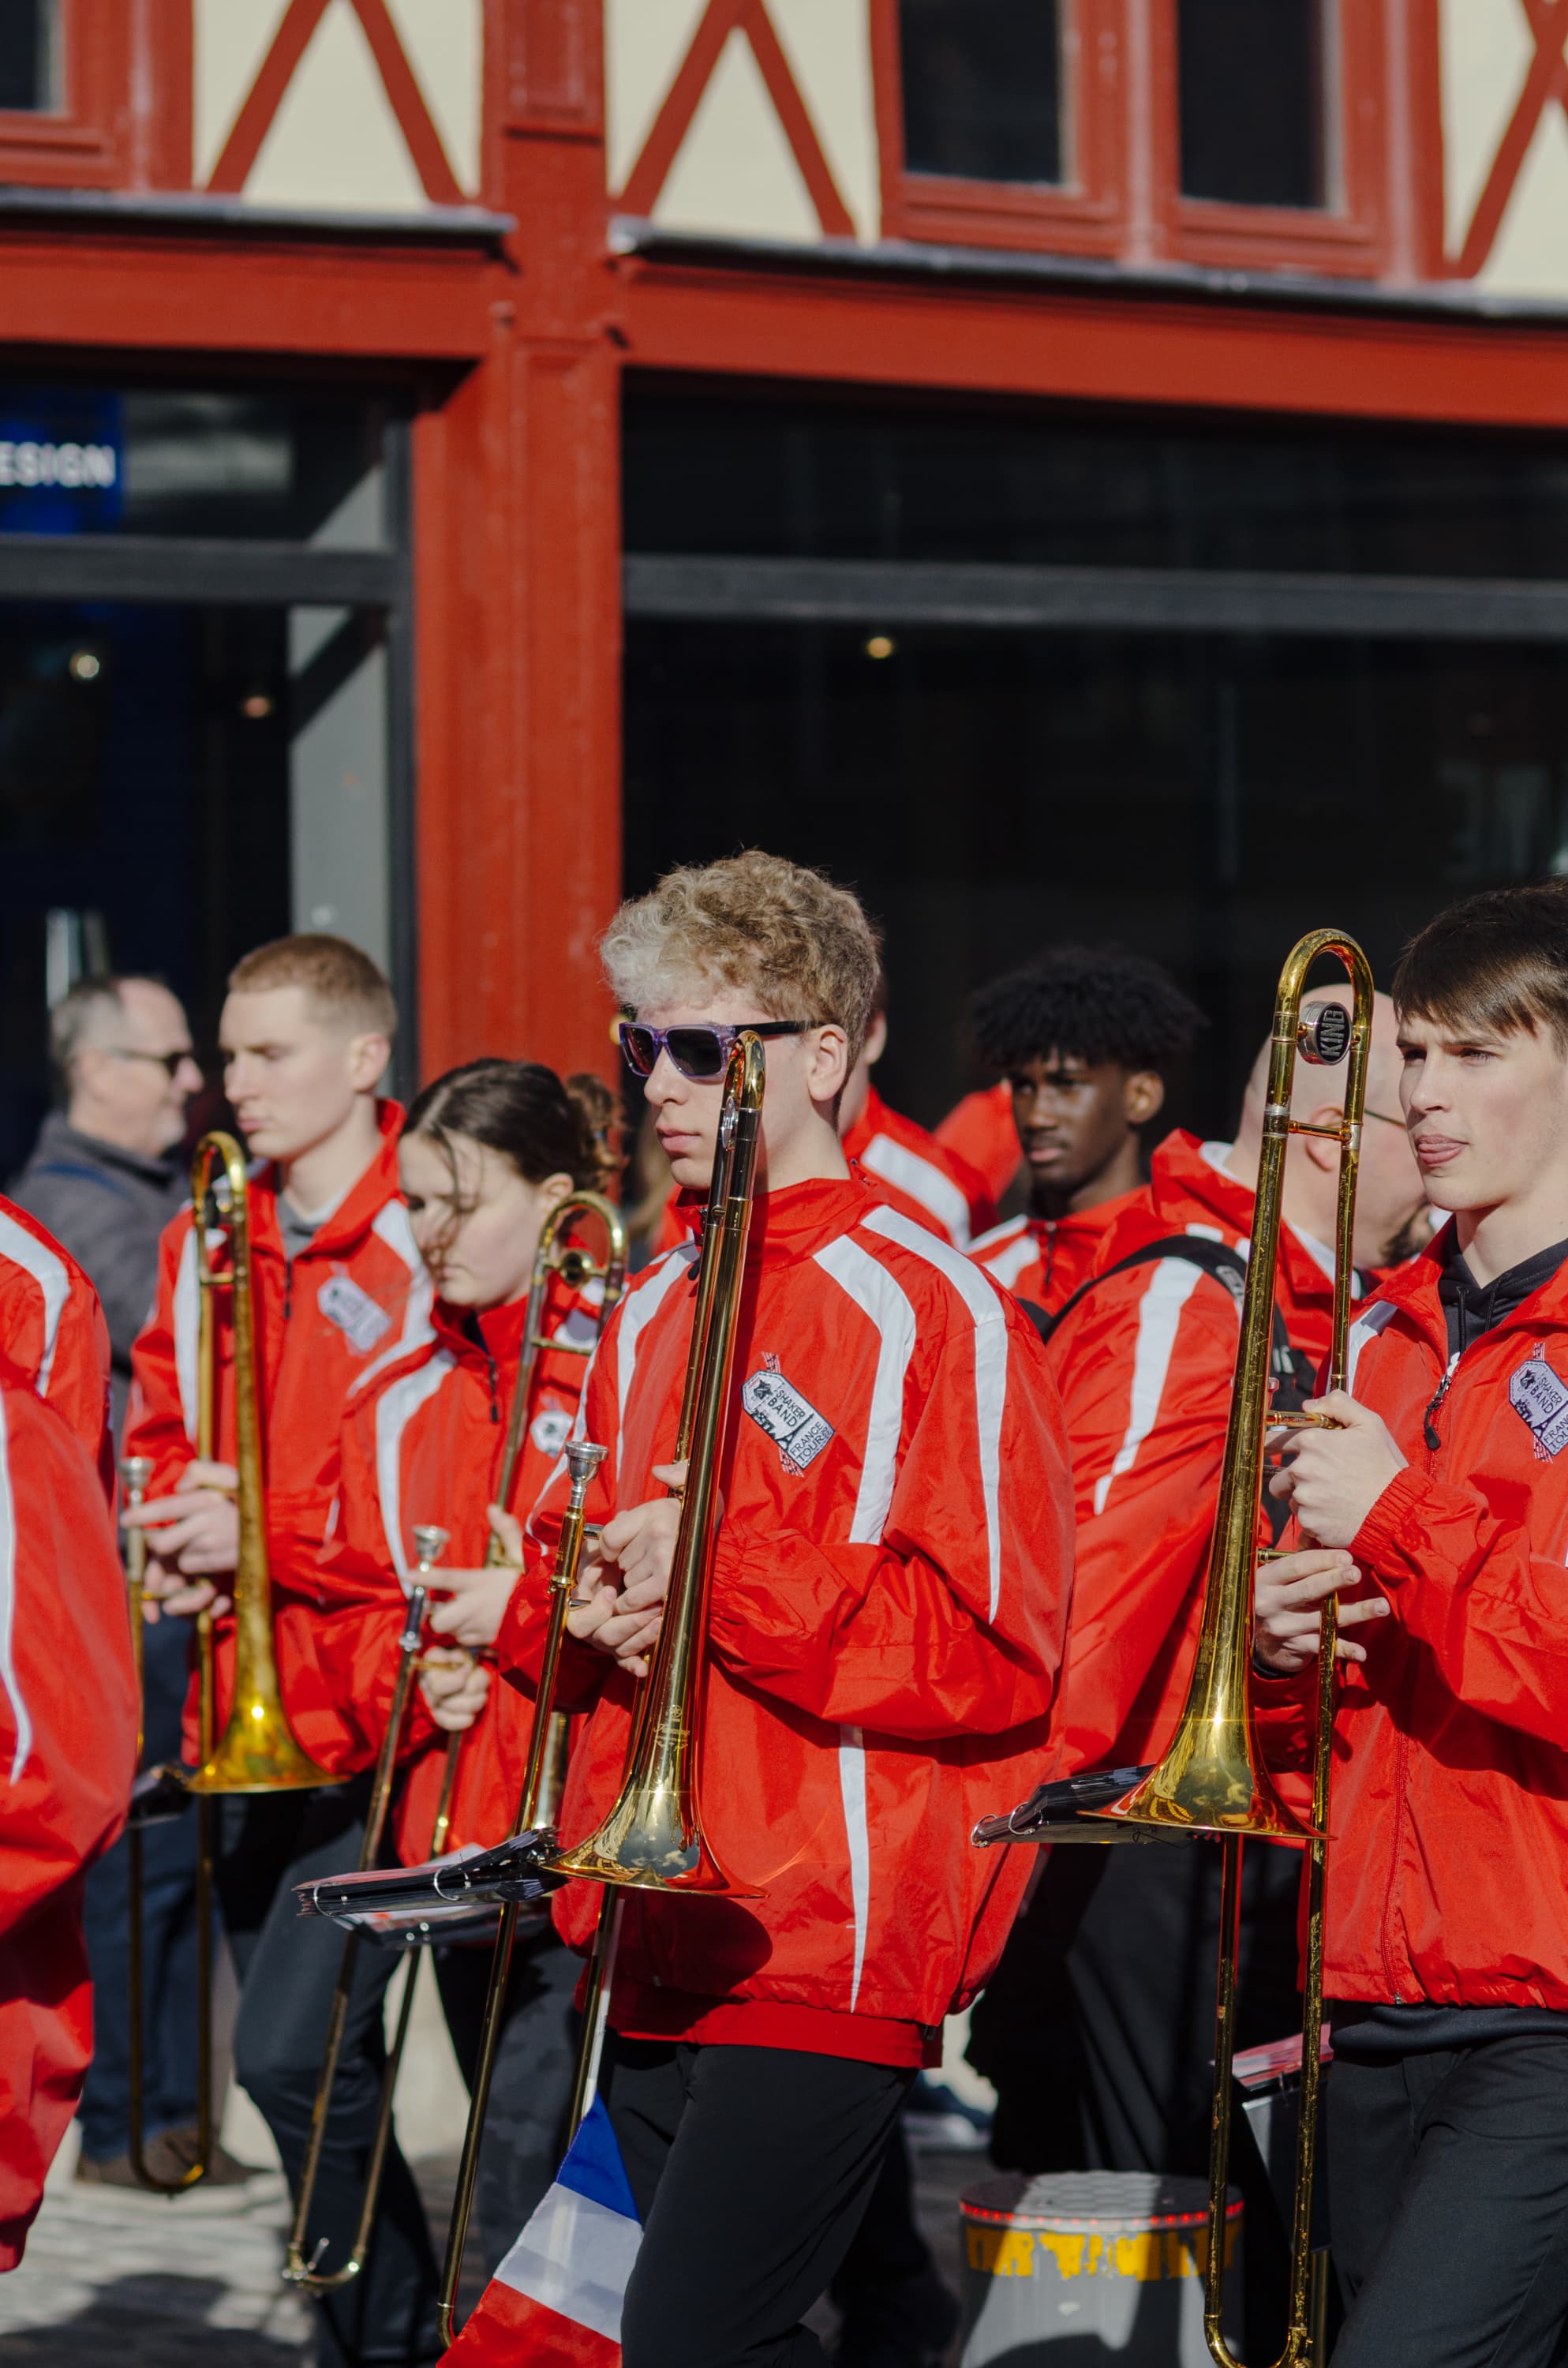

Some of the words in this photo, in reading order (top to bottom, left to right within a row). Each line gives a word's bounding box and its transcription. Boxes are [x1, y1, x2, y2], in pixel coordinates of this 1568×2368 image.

[1319, 1010, 1345, 1057] KING
[776, 1389, 806, 1419] SHAKER
[1530, 1385, 1554, 1414] BAND
[1538, 1377, 1562, 1407] SHAKER
[767, 1397, 798, 1427] BAND
[790, 1422, 823, 1457] FRANCE
[795, 1436, 825, 1462] TOUR
